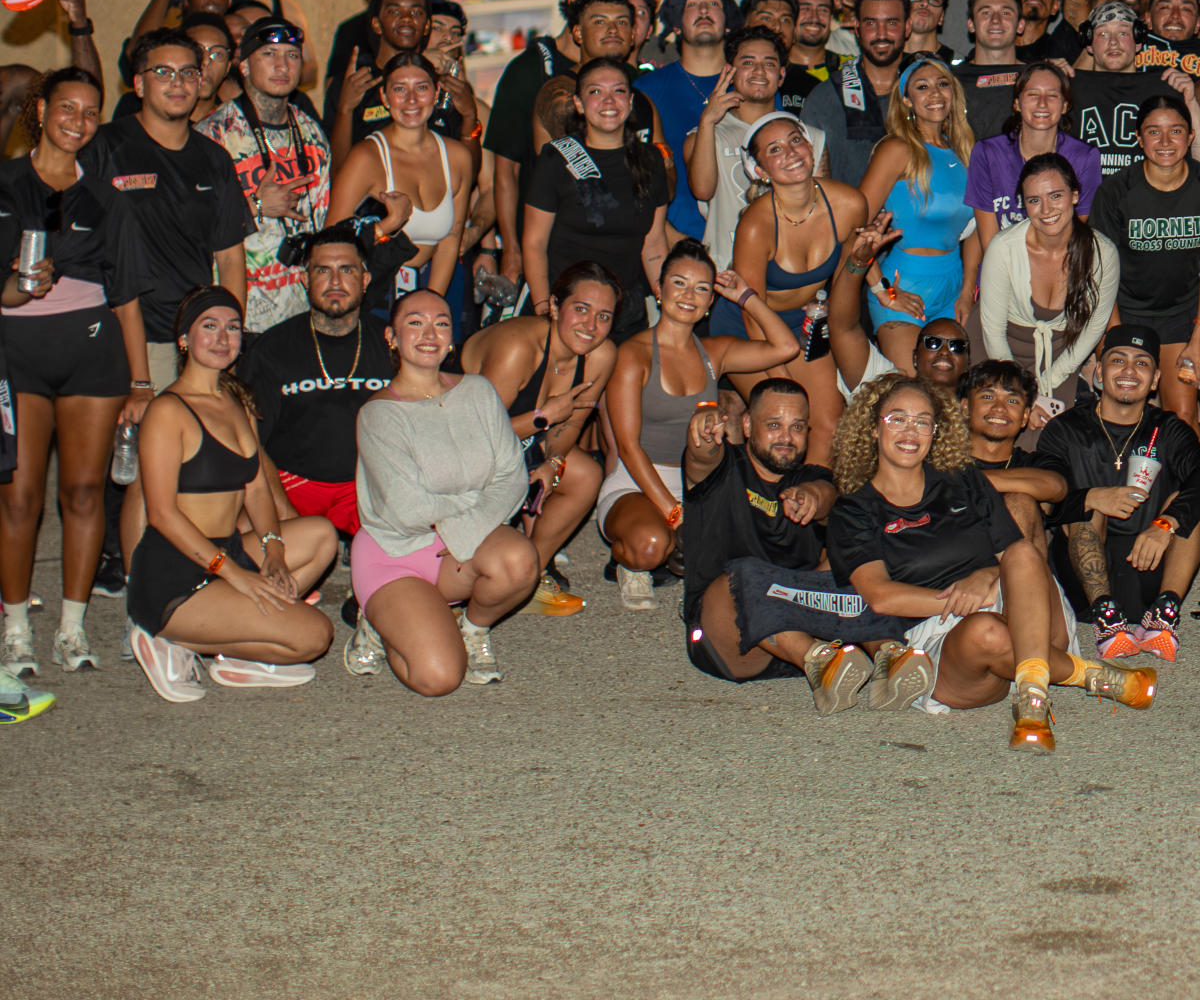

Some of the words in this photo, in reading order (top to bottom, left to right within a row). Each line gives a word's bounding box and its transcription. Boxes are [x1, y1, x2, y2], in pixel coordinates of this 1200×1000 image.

[1134, 45, 1181, 68] ocket
[1100, 153, 1132, 167] NNING
[1128, 239, 1162, 252] CROSS
